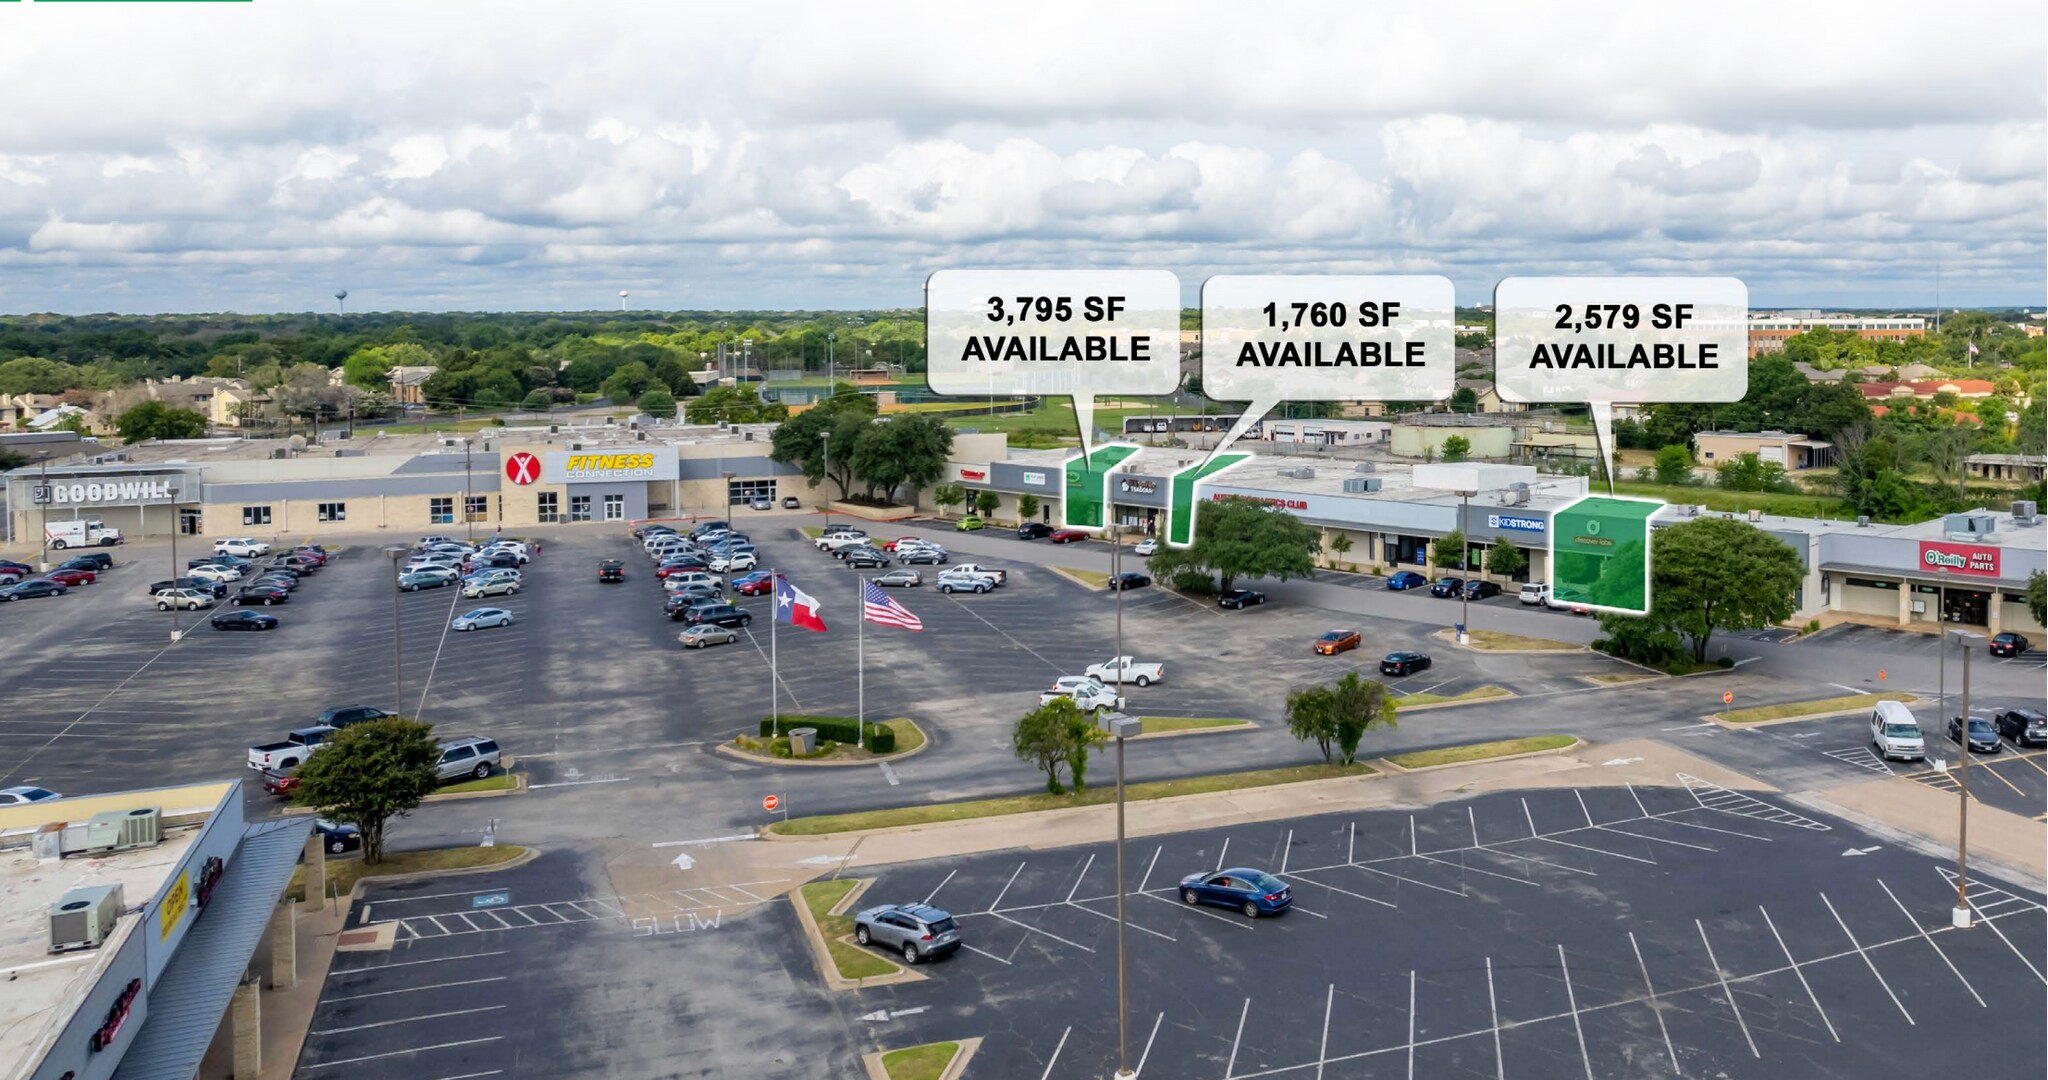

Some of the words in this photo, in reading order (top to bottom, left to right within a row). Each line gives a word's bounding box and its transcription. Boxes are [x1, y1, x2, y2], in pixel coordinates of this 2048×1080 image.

[566, 453, 655, 470] FITNESS
[565, 469, 654, 478] CONNECTION
[53, 481, 174, 503] GOODWILL
[1286, 500, 1308, 510] CLUB
[1499, 518, 1544, 530] KIDSTRONG
[1925, 550, 1967, 568] O'Reilly
[1972, 552, 1993, 562] AUTO
[1969, 561, 1994, 571] PARTS
[632, 908, 722, 938] SLOW
